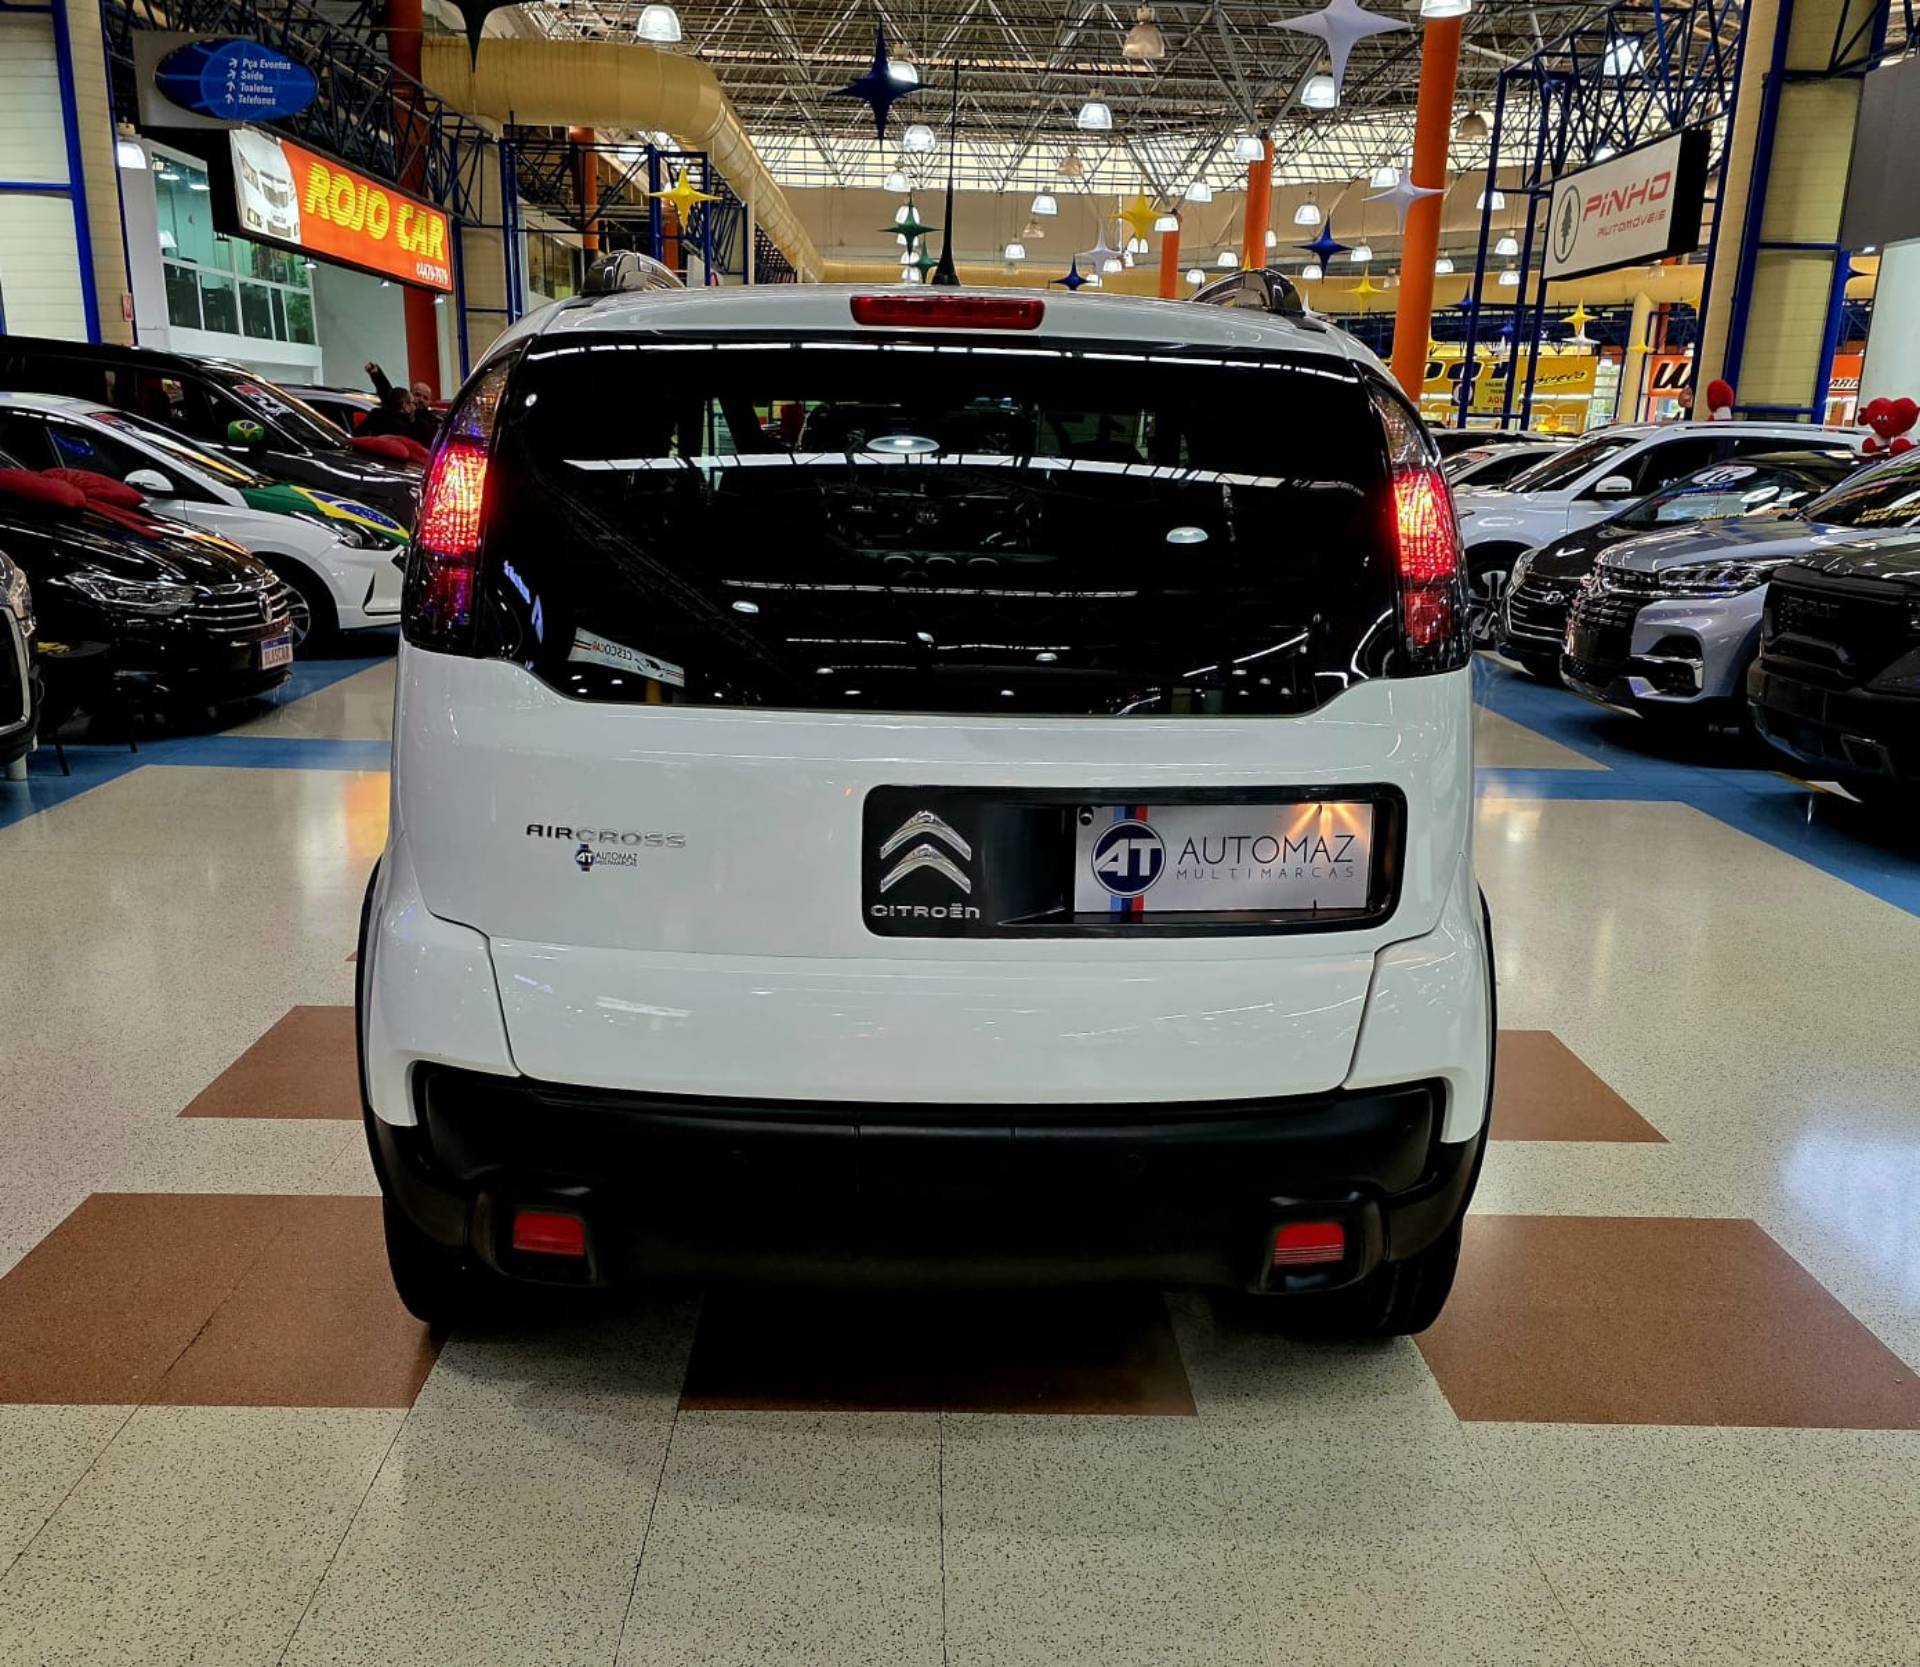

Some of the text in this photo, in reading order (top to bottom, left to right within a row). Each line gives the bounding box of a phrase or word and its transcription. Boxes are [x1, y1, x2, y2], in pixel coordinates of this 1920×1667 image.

[260, 59, 291, 70] Eventos
[240, 83, 273, 93] Toaletes
[238, 94, 276, 105] Telefones
[1583, 171, 1671, 222] PINHO
[304, 162, 444, 261] ROJO CAR
[526, 824, 687, 848] AIRCROSS
[1178, 835, 1356, 865] AUTOMAZ
[1176, 867, 1354, 880] MULTIMARCAS
[871, 903, 980, 919] CITROËN
